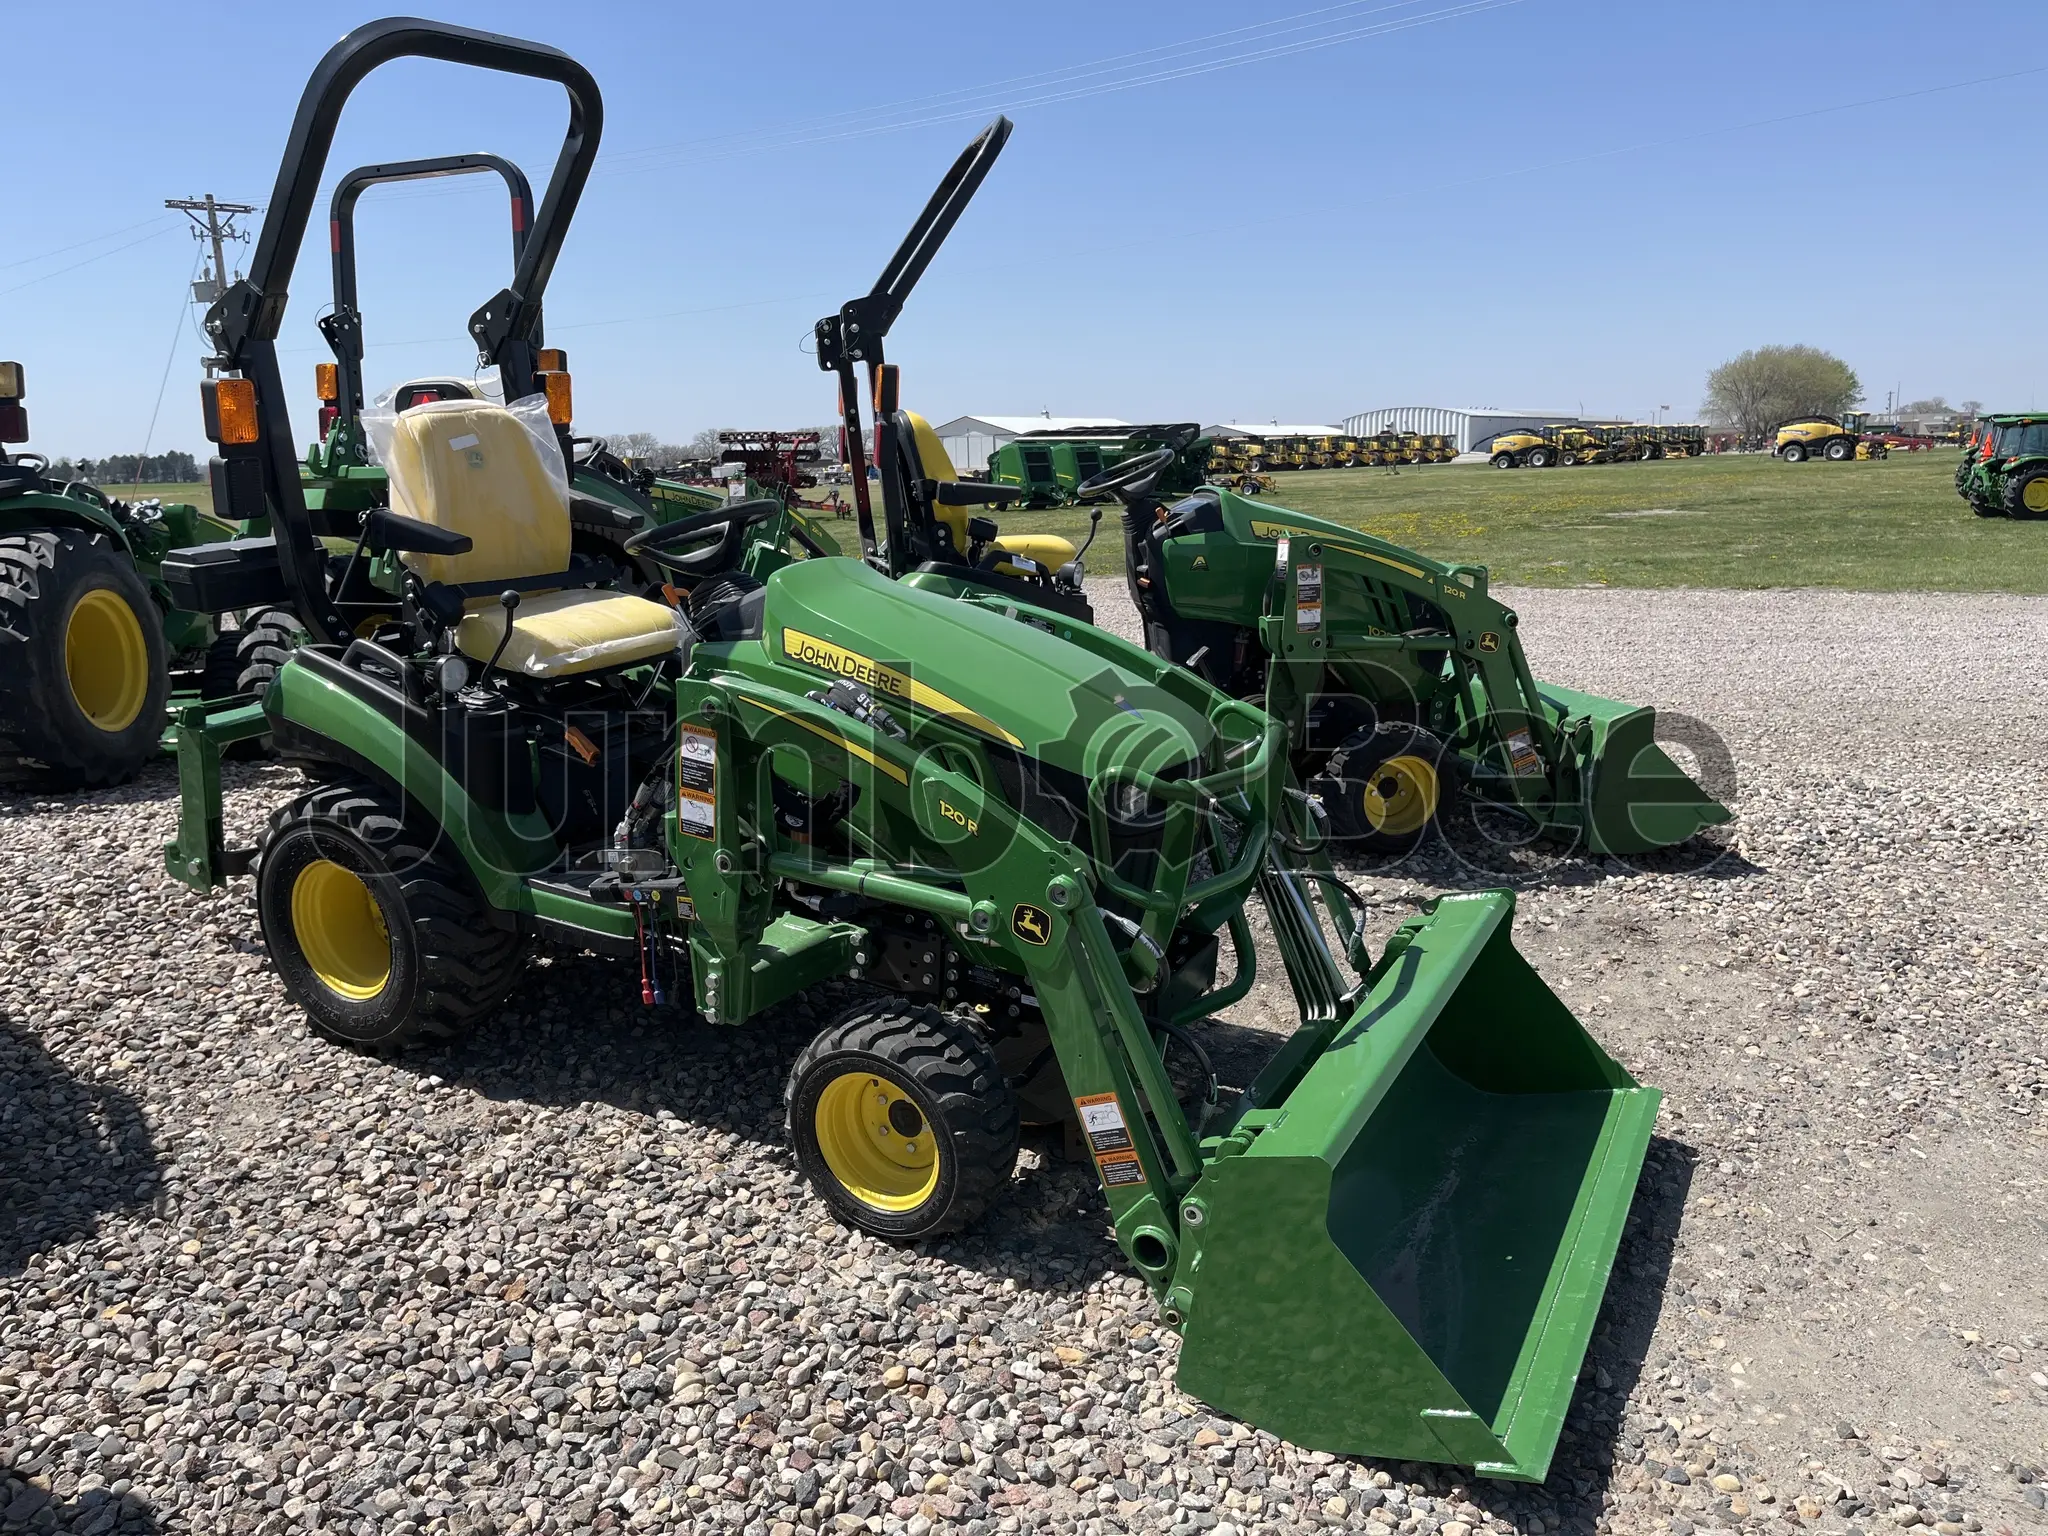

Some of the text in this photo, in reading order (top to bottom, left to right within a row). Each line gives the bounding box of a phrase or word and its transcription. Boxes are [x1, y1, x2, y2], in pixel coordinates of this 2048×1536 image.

[671, 492, 690, 504] JOHN
[1443, 584, 1466, 600] 120 R
[793, 640, 902, 694] JOHN DEERE
[687, 726, 716, 739] WARNING
[686, 792, 714, 804] WARNING
[939, 800, 979, 837] 120 R
[1086, 1095, 1113, 1105] WARNING
[1107, 1154, 1135, 1163] WARNING
